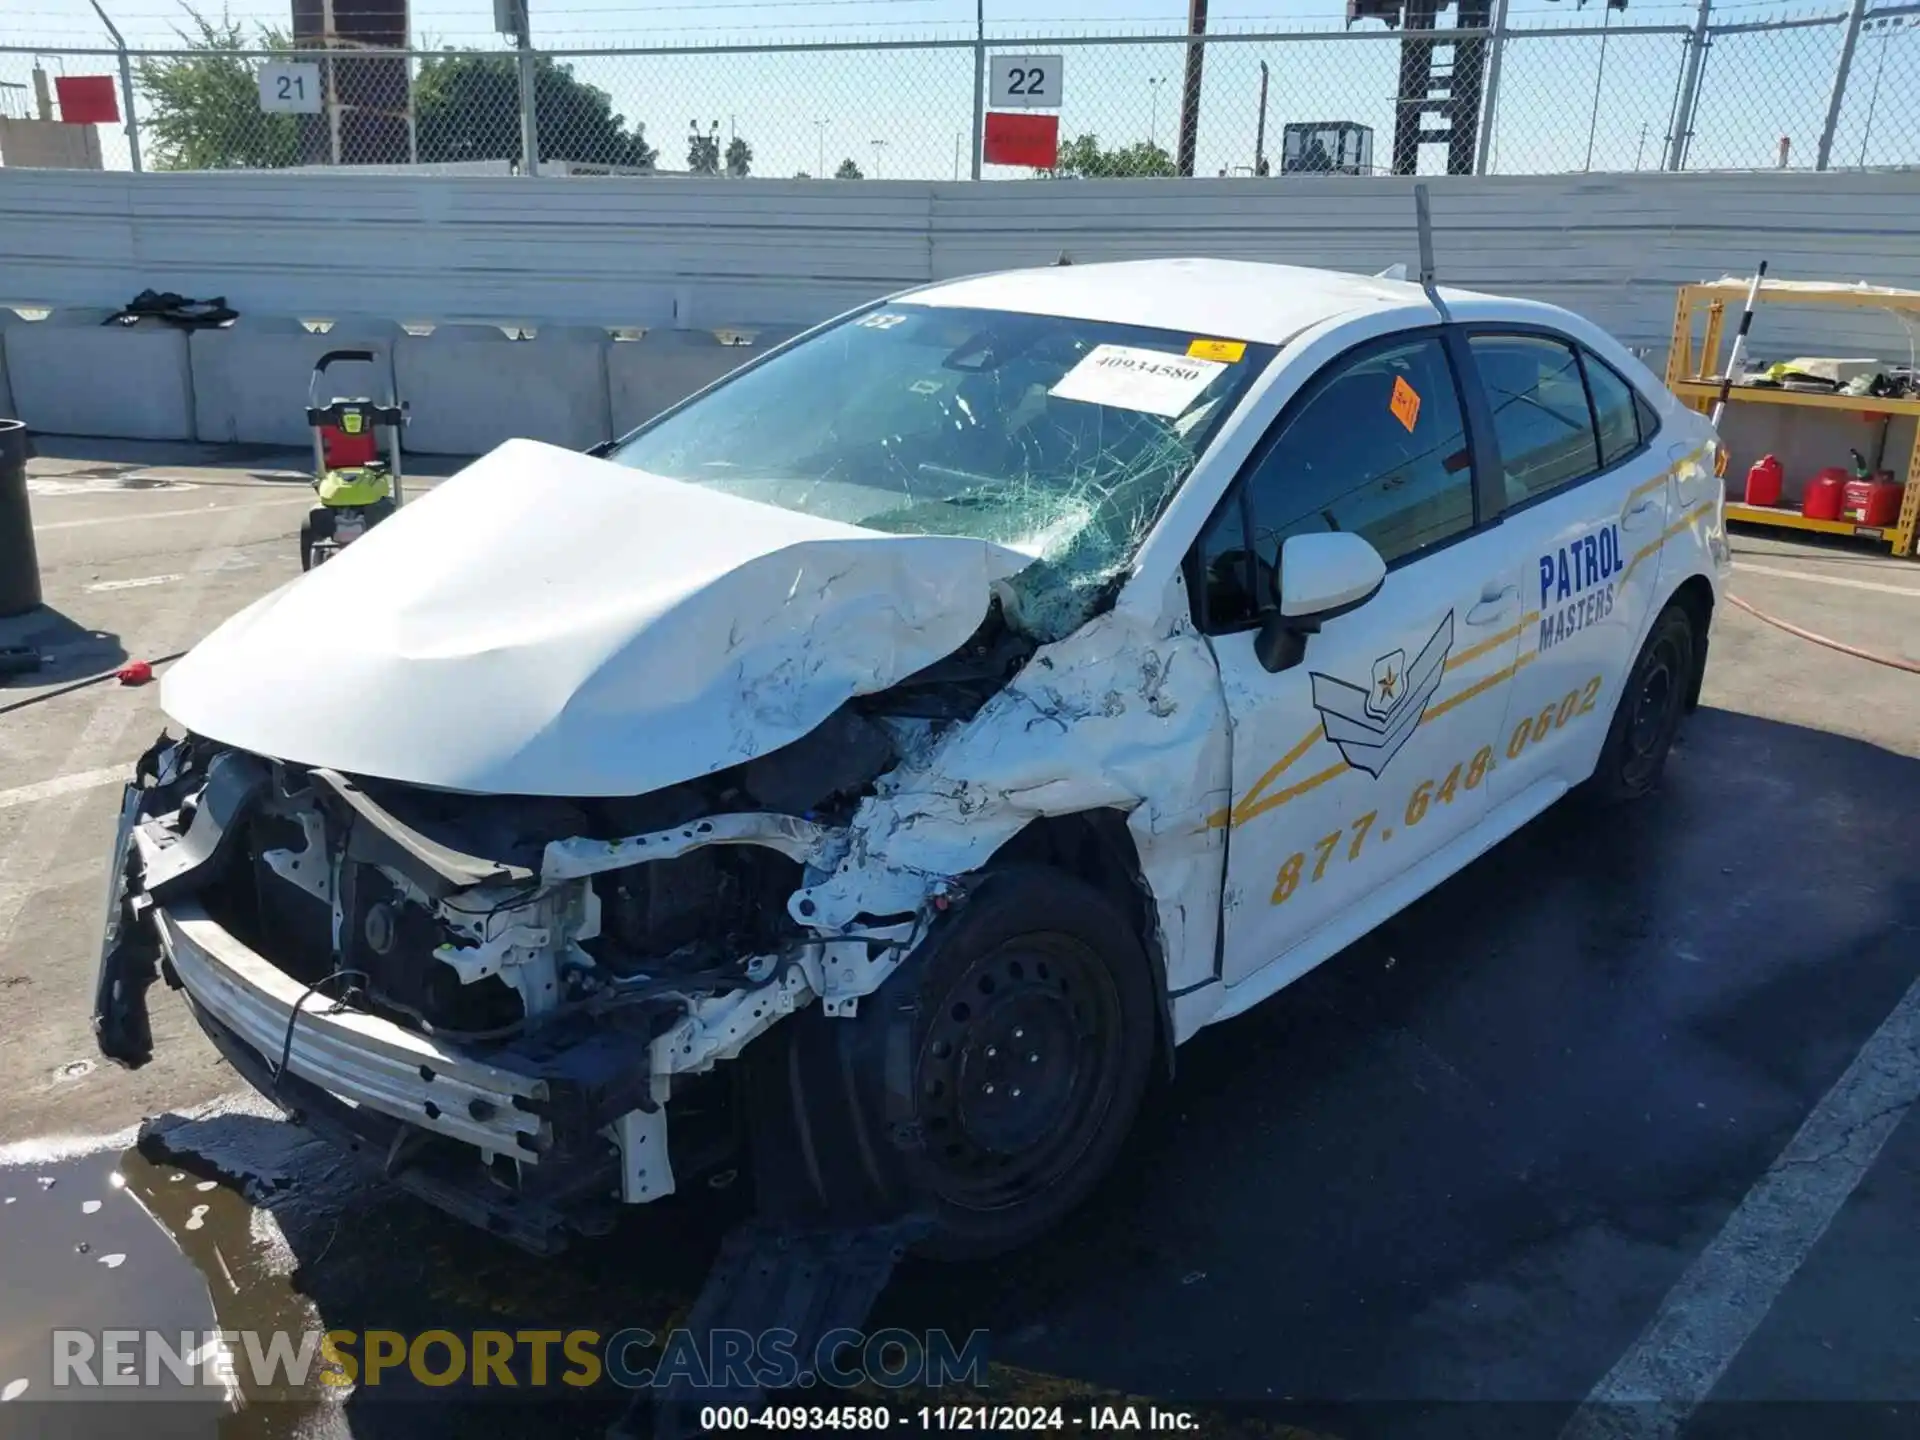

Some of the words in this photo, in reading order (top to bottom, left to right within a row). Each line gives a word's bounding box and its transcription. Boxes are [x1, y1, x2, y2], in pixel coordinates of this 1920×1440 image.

[277, 75, 304, 100] 21
[1008, 67, 1045, 95] 22
[1095, 356, 1200, 381] 40934580
[1540, 523, 1624, 611] PATROL
[1538, 582, 1614, 653] MASTERS
[1270, 674, 1602, 906] 877.648.0602
